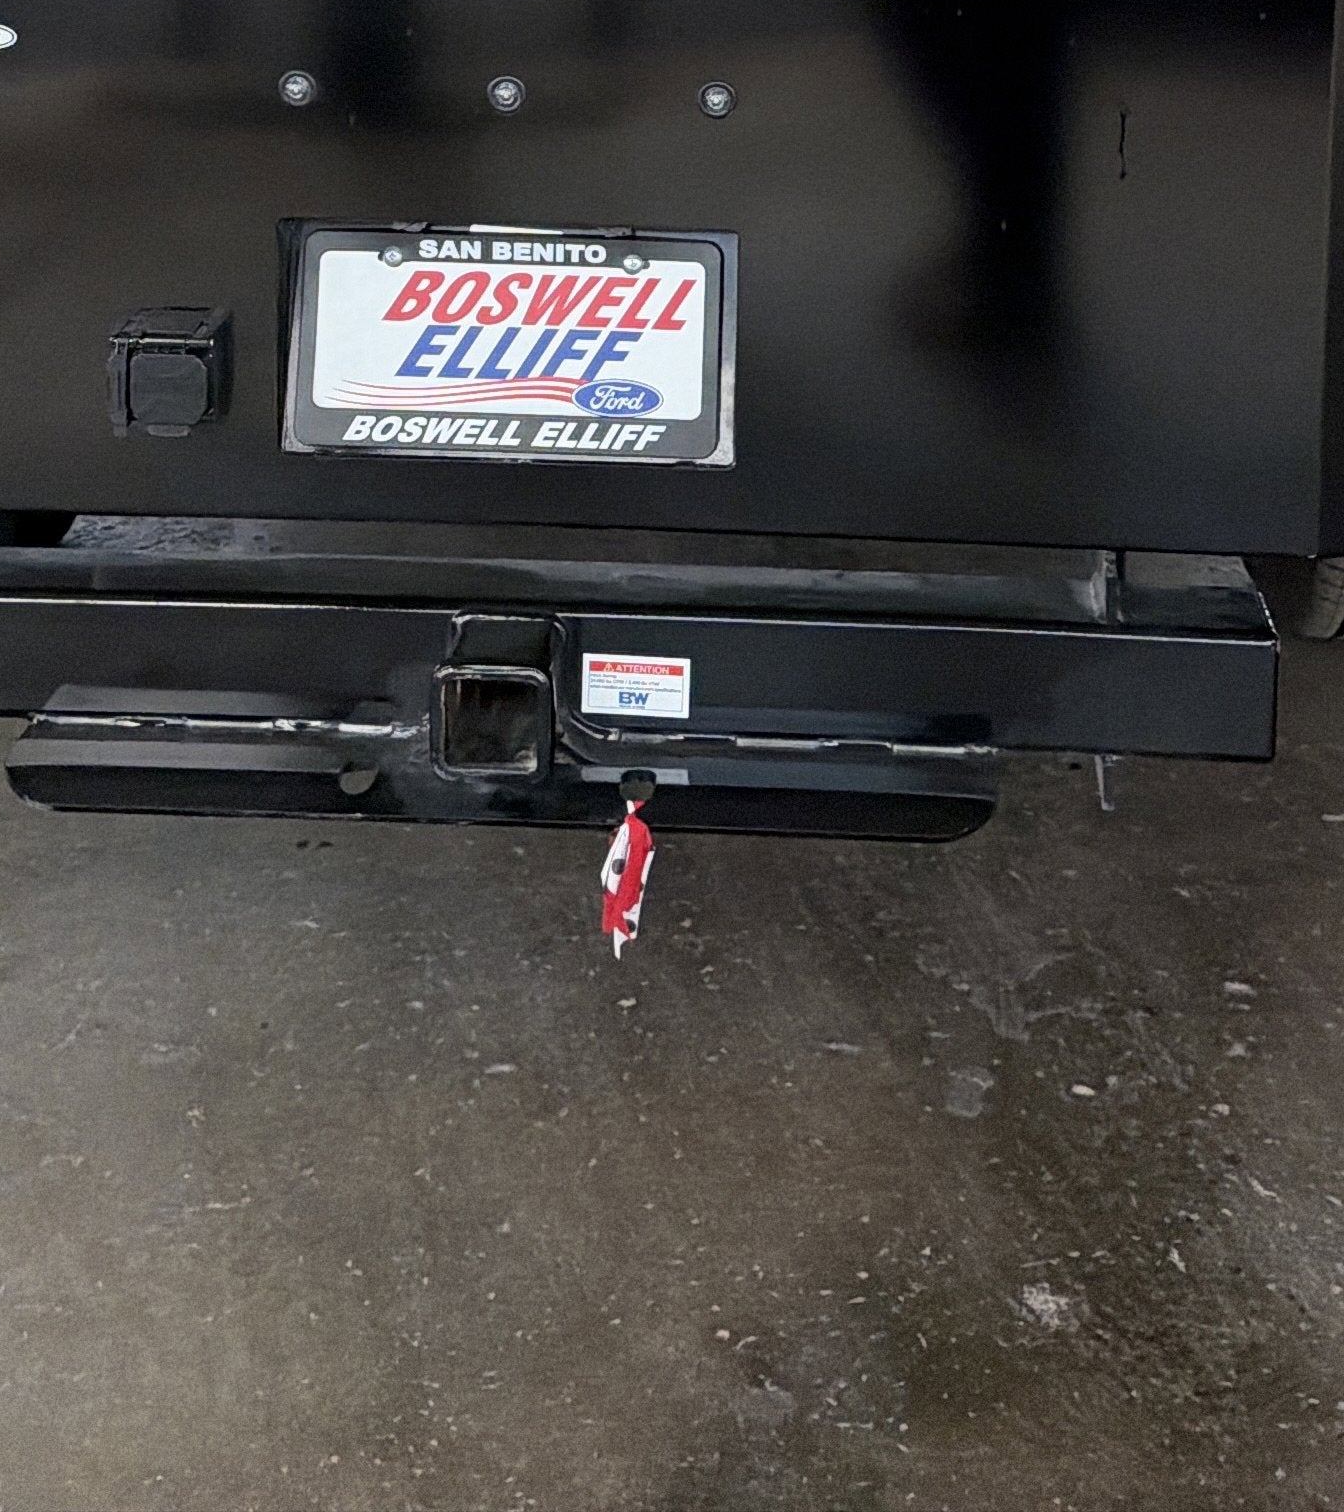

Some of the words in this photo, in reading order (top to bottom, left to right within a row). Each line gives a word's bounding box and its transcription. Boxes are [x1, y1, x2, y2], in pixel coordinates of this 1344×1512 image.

[418, 239, 484, 261] SAN
[492, 241, 607, 265] BENITO
[381, 270, 697, 331] BOSWELL
[394, 324, 644, 381] ELLIFF
[589, 386, 645, 412] Ford
[342, 415, 523, 448] BOSWELL
[530, 422, 667, 451] ELLIFF
[615, 664, 670, 675] ATTENTION
